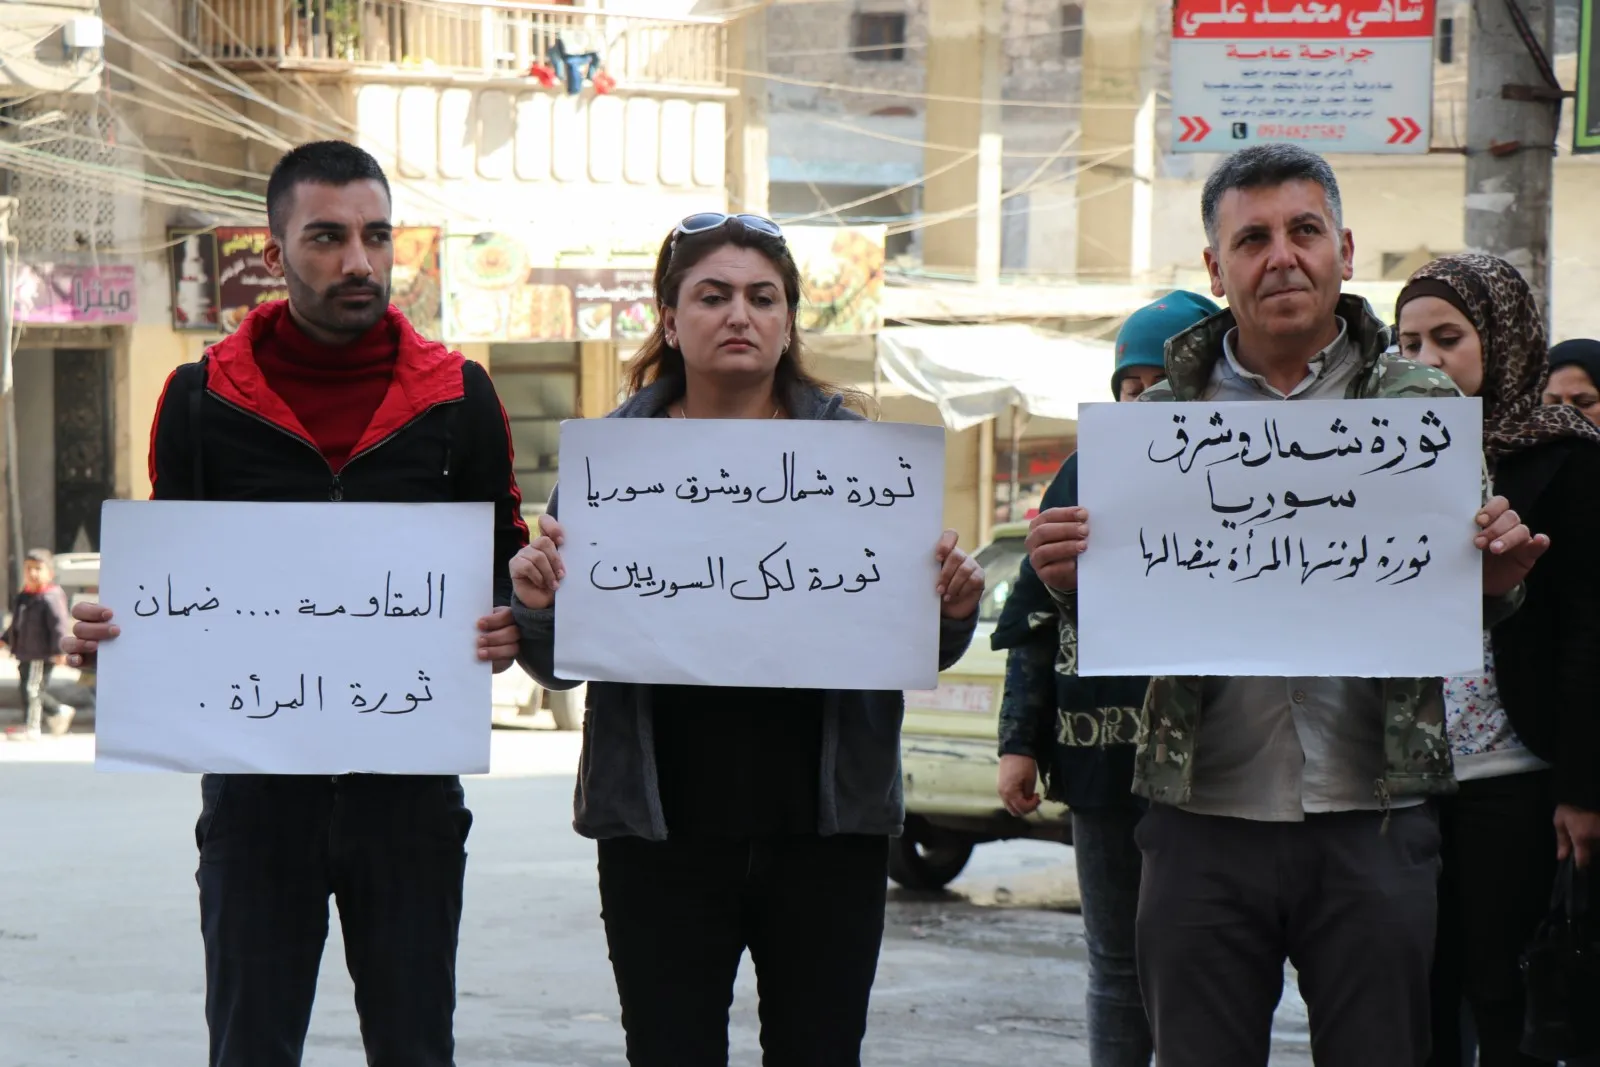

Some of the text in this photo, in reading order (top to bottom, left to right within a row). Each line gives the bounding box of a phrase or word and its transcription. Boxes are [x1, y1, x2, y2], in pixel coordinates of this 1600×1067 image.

[1181, 0, 1249, 36] علي
[1253, 0, 1343, 24] محمد
[1226, 44, 1374, 62] جراحة عامة
[1148, 410, 1452, 476] ثورة شمال وشرق
[586, 451, 915, 508] ثورة شمال وشرق سوريا
[1207, 469, 1357, 530] سوريا
[590, 541, 881, 601] ثورة لكل السوريين
[1139, 527, 1221, 579] بنضالها
[1228, 528, 1292, 583] المرأة
[1375, 534, 1431, 586] ثورة
[134, 573, 220, 617] ضمان
[229, 673, 323, 719] المرأة
[349, 670, 433, 715] ثورة
